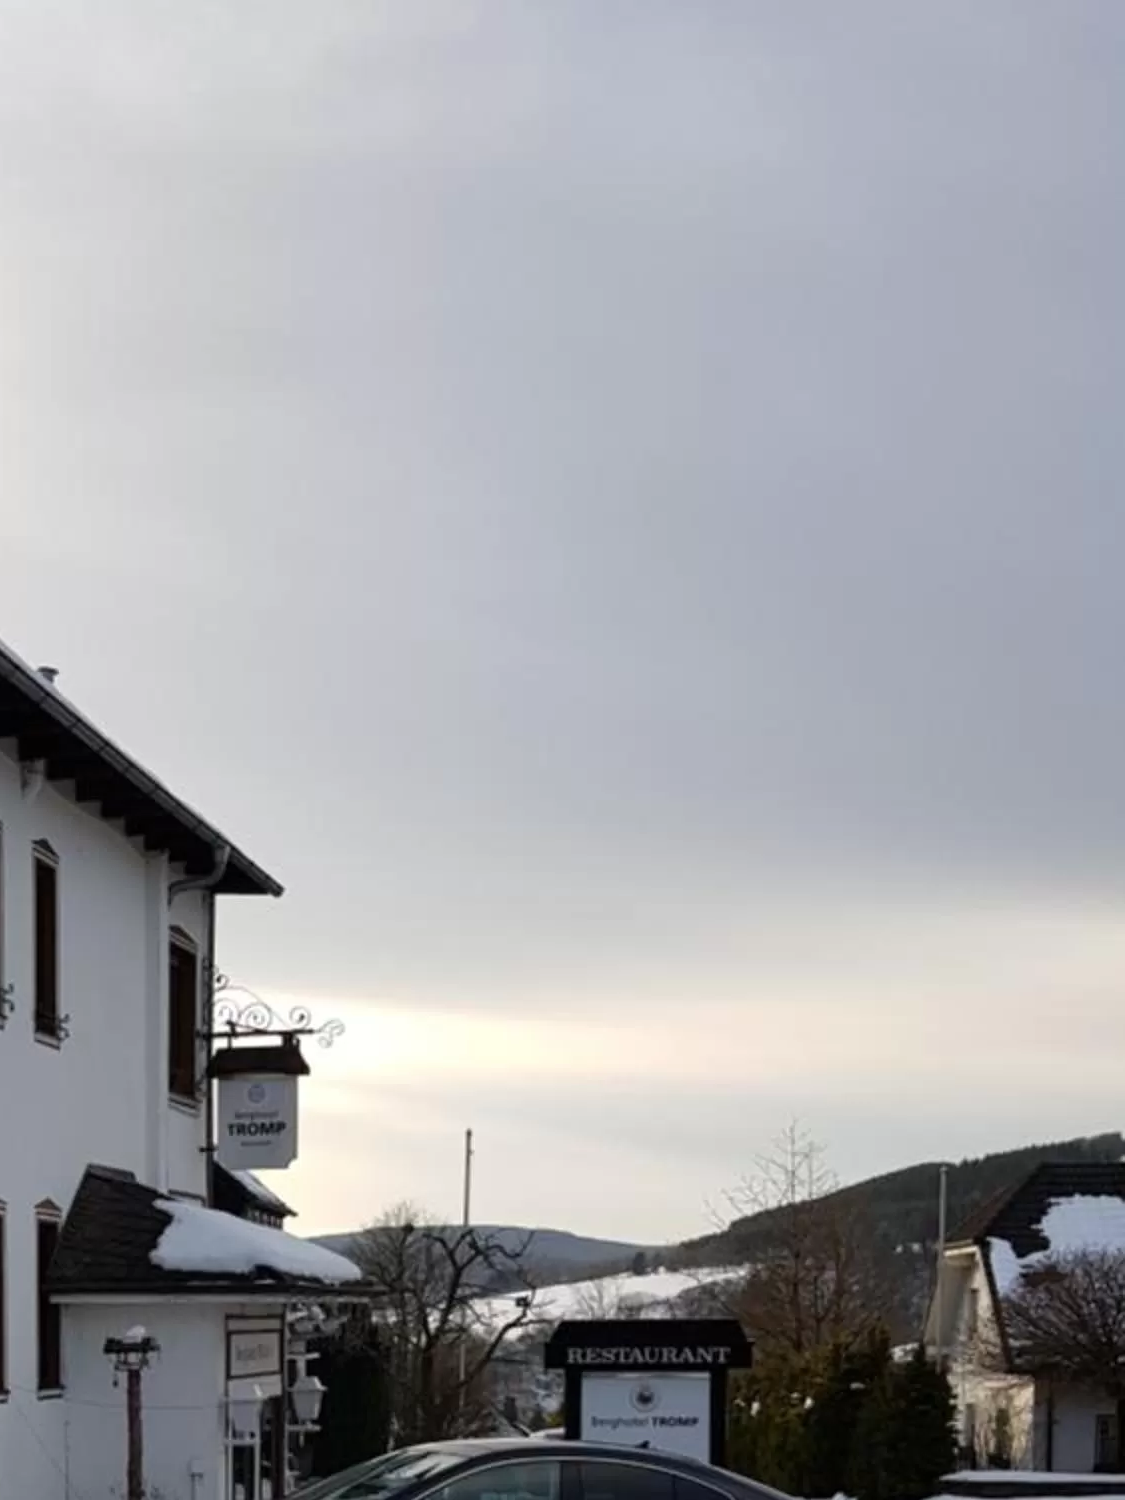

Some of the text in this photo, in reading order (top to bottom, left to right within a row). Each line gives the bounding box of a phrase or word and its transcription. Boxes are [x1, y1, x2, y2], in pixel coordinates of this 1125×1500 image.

[227, 1121, 287, 1137] TROMP
[566, 1345, 732, 1365] RESTAURANT
[651, 1415, 701, 1427] TROMP
